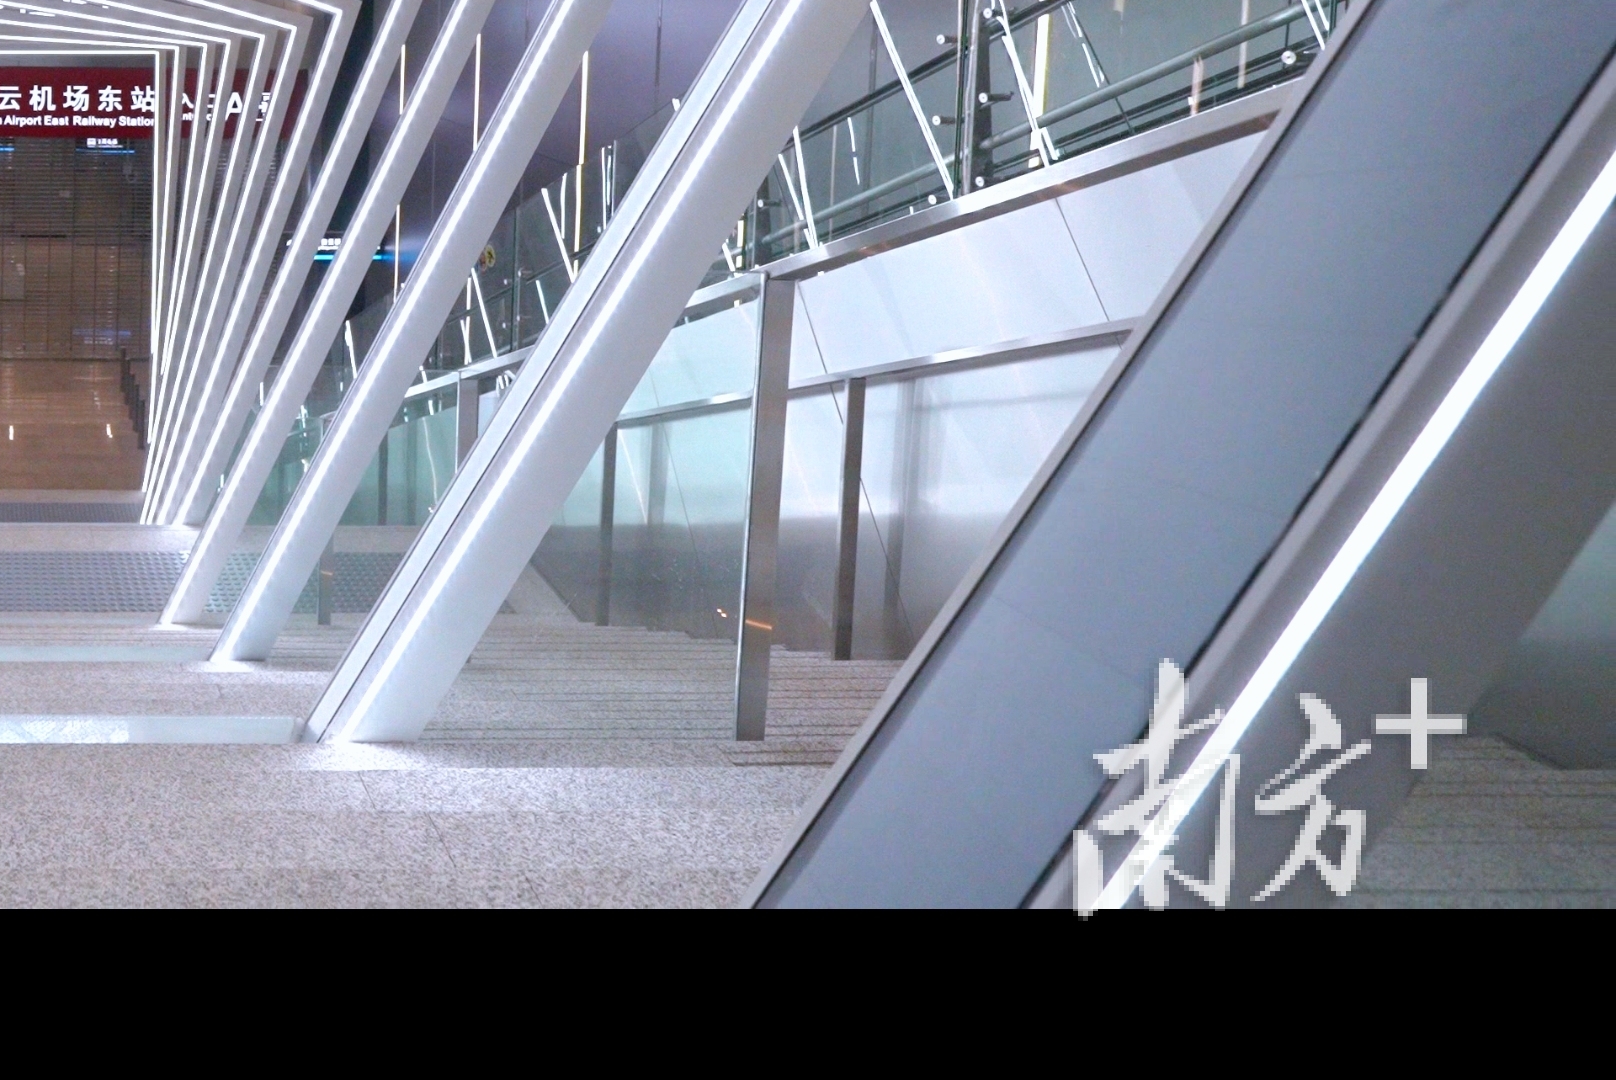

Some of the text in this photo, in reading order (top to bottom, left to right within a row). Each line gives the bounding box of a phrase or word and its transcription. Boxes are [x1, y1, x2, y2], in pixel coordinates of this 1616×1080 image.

[4, 114, 42, 128] Airport
[44, 115, 69, 127] East
[72, 115, 117, 129] Railway
